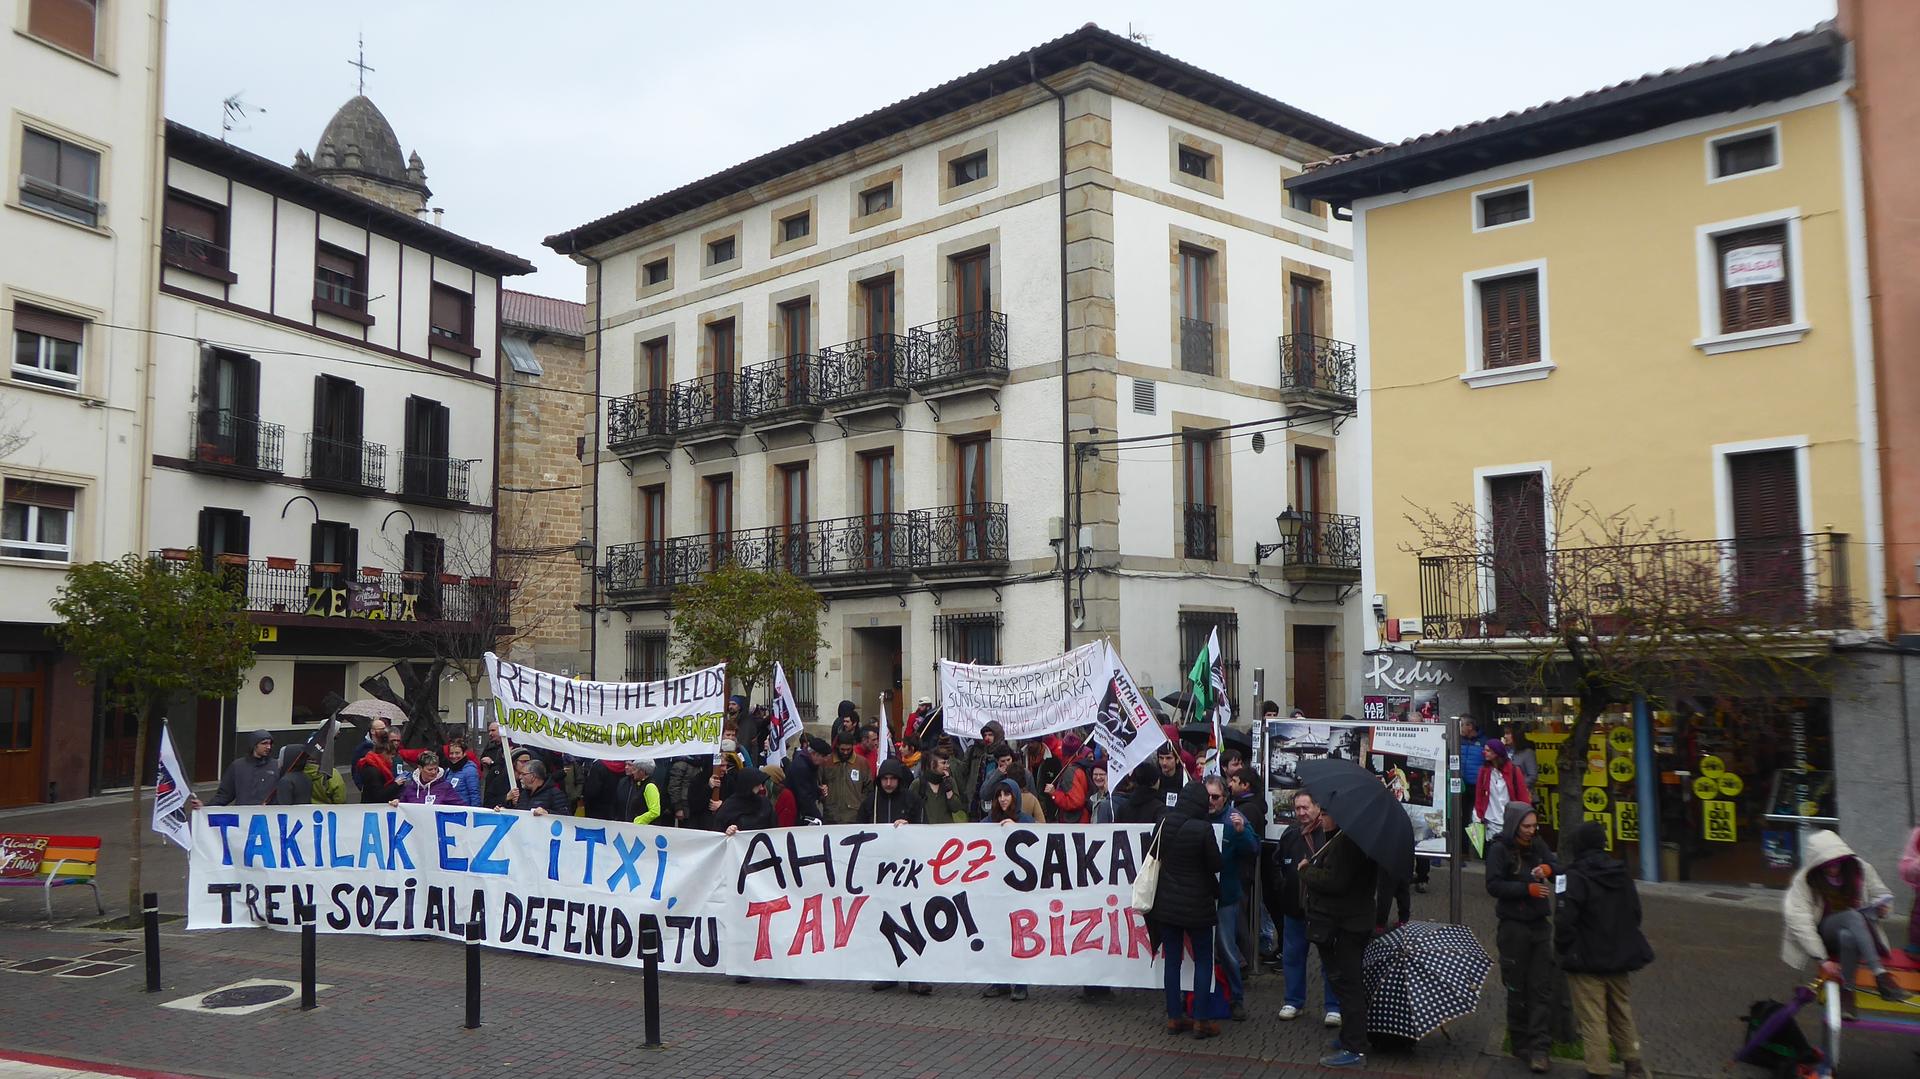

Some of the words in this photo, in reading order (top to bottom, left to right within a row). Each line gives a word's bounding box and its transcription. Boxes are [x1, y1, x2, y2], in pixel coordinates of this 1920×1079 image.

[497, 659, 604, 716] RECLAIM
[607, 682, 656, 710] THE
[957, 680, 984, 694] ETA
[1043, 677, 1093, 703] AURKA
[1365, 654, 1453, 691] Redin
[495, 697, 553, 737] LURRA
[207, 810, 416, 870] TAKILAK
[435, 811, 519, 875] EZ
[207, 883, 314, 926] TREN
[327, 878, 487, 940] SOZIALA
[500, 891, 720, 967] DEFENDATU
[746, 893, 870, 961] TAV
[880, 891, 984, 968] NO!
[1009, 894, 1195, 960] BIZIR
